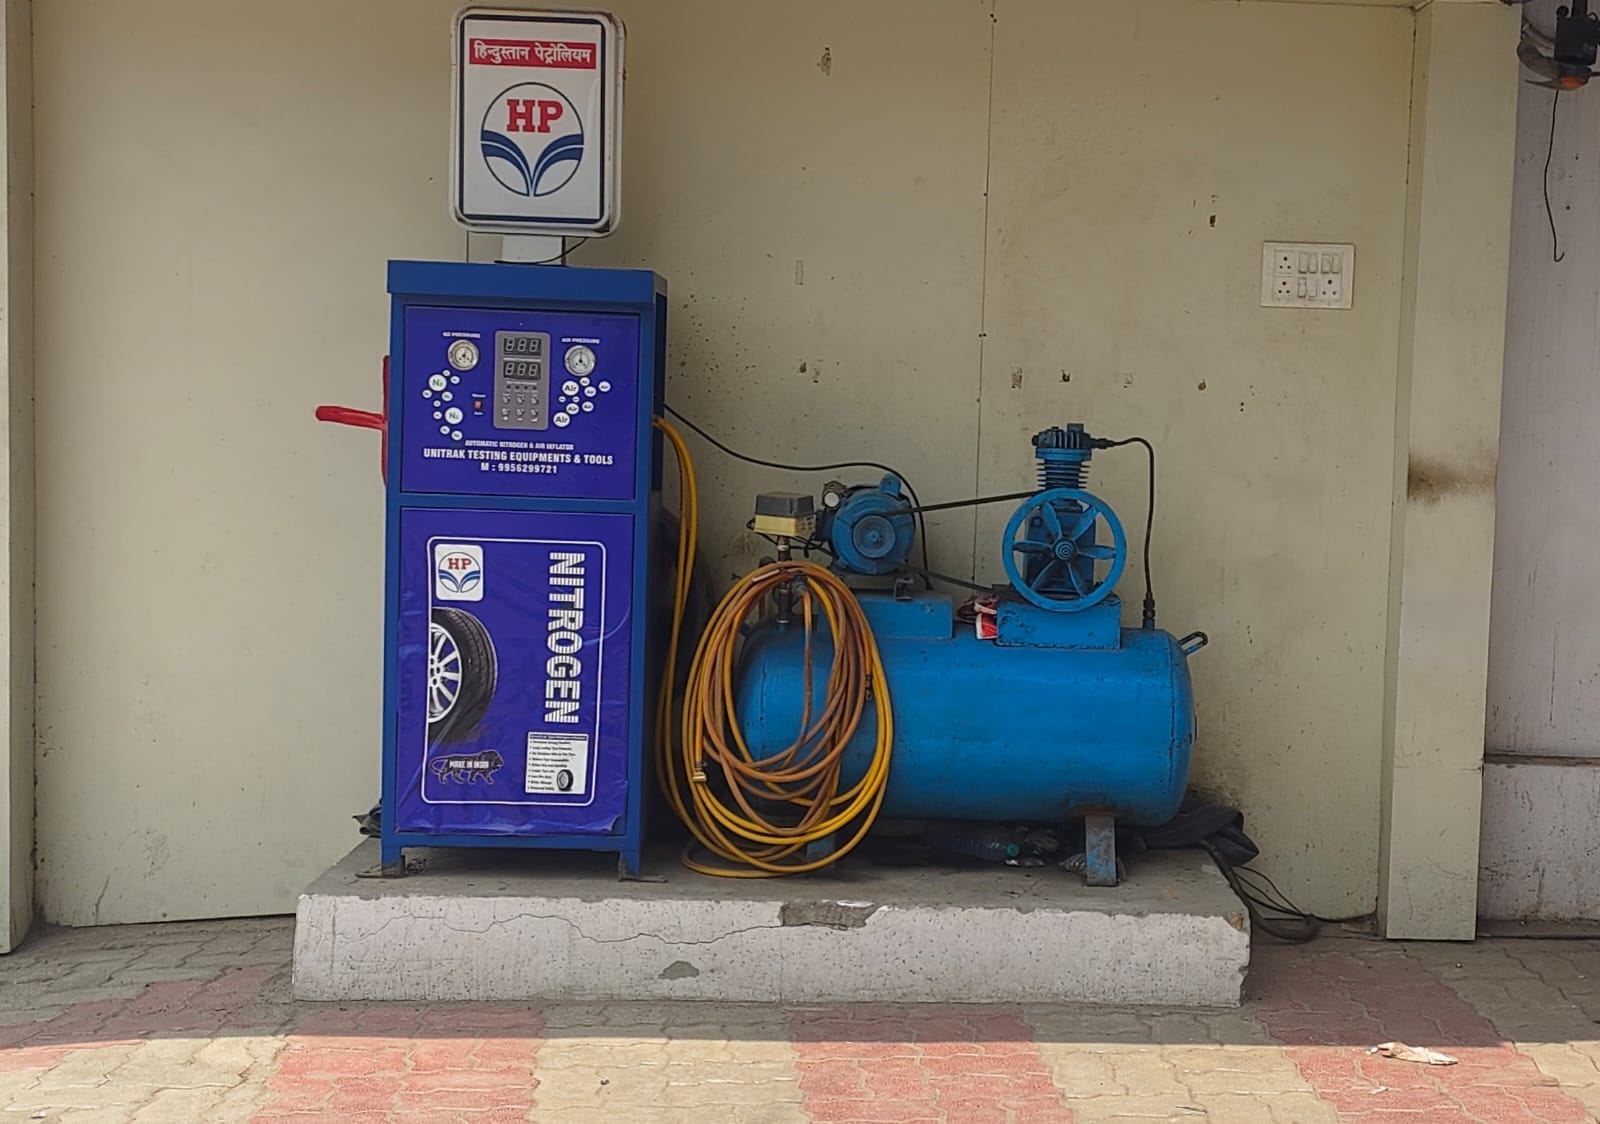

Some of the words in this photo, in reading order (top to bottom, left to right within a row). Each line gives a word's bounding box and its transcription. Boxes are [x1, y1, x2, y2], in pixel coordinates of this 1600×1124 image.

[474, 40, 530, 64] हिन्दुस्तान
[534, 42, 592, 64] पेट्रोलियम
[507, 99, 563, 133] HP
[423, 448, 465, 459] UNITRAK
[467, 449, 507, 460] TESTING
[509, 451, 572, 463] EQUIPMENTS
[573, 454, 581, 464] &
[583, 454, 613, 465] TOOLS
[498, 463, 557, 474] 9956299721
[447, 557, 472, 570] HP
[544, 552, 585, 723] NITROGEN
